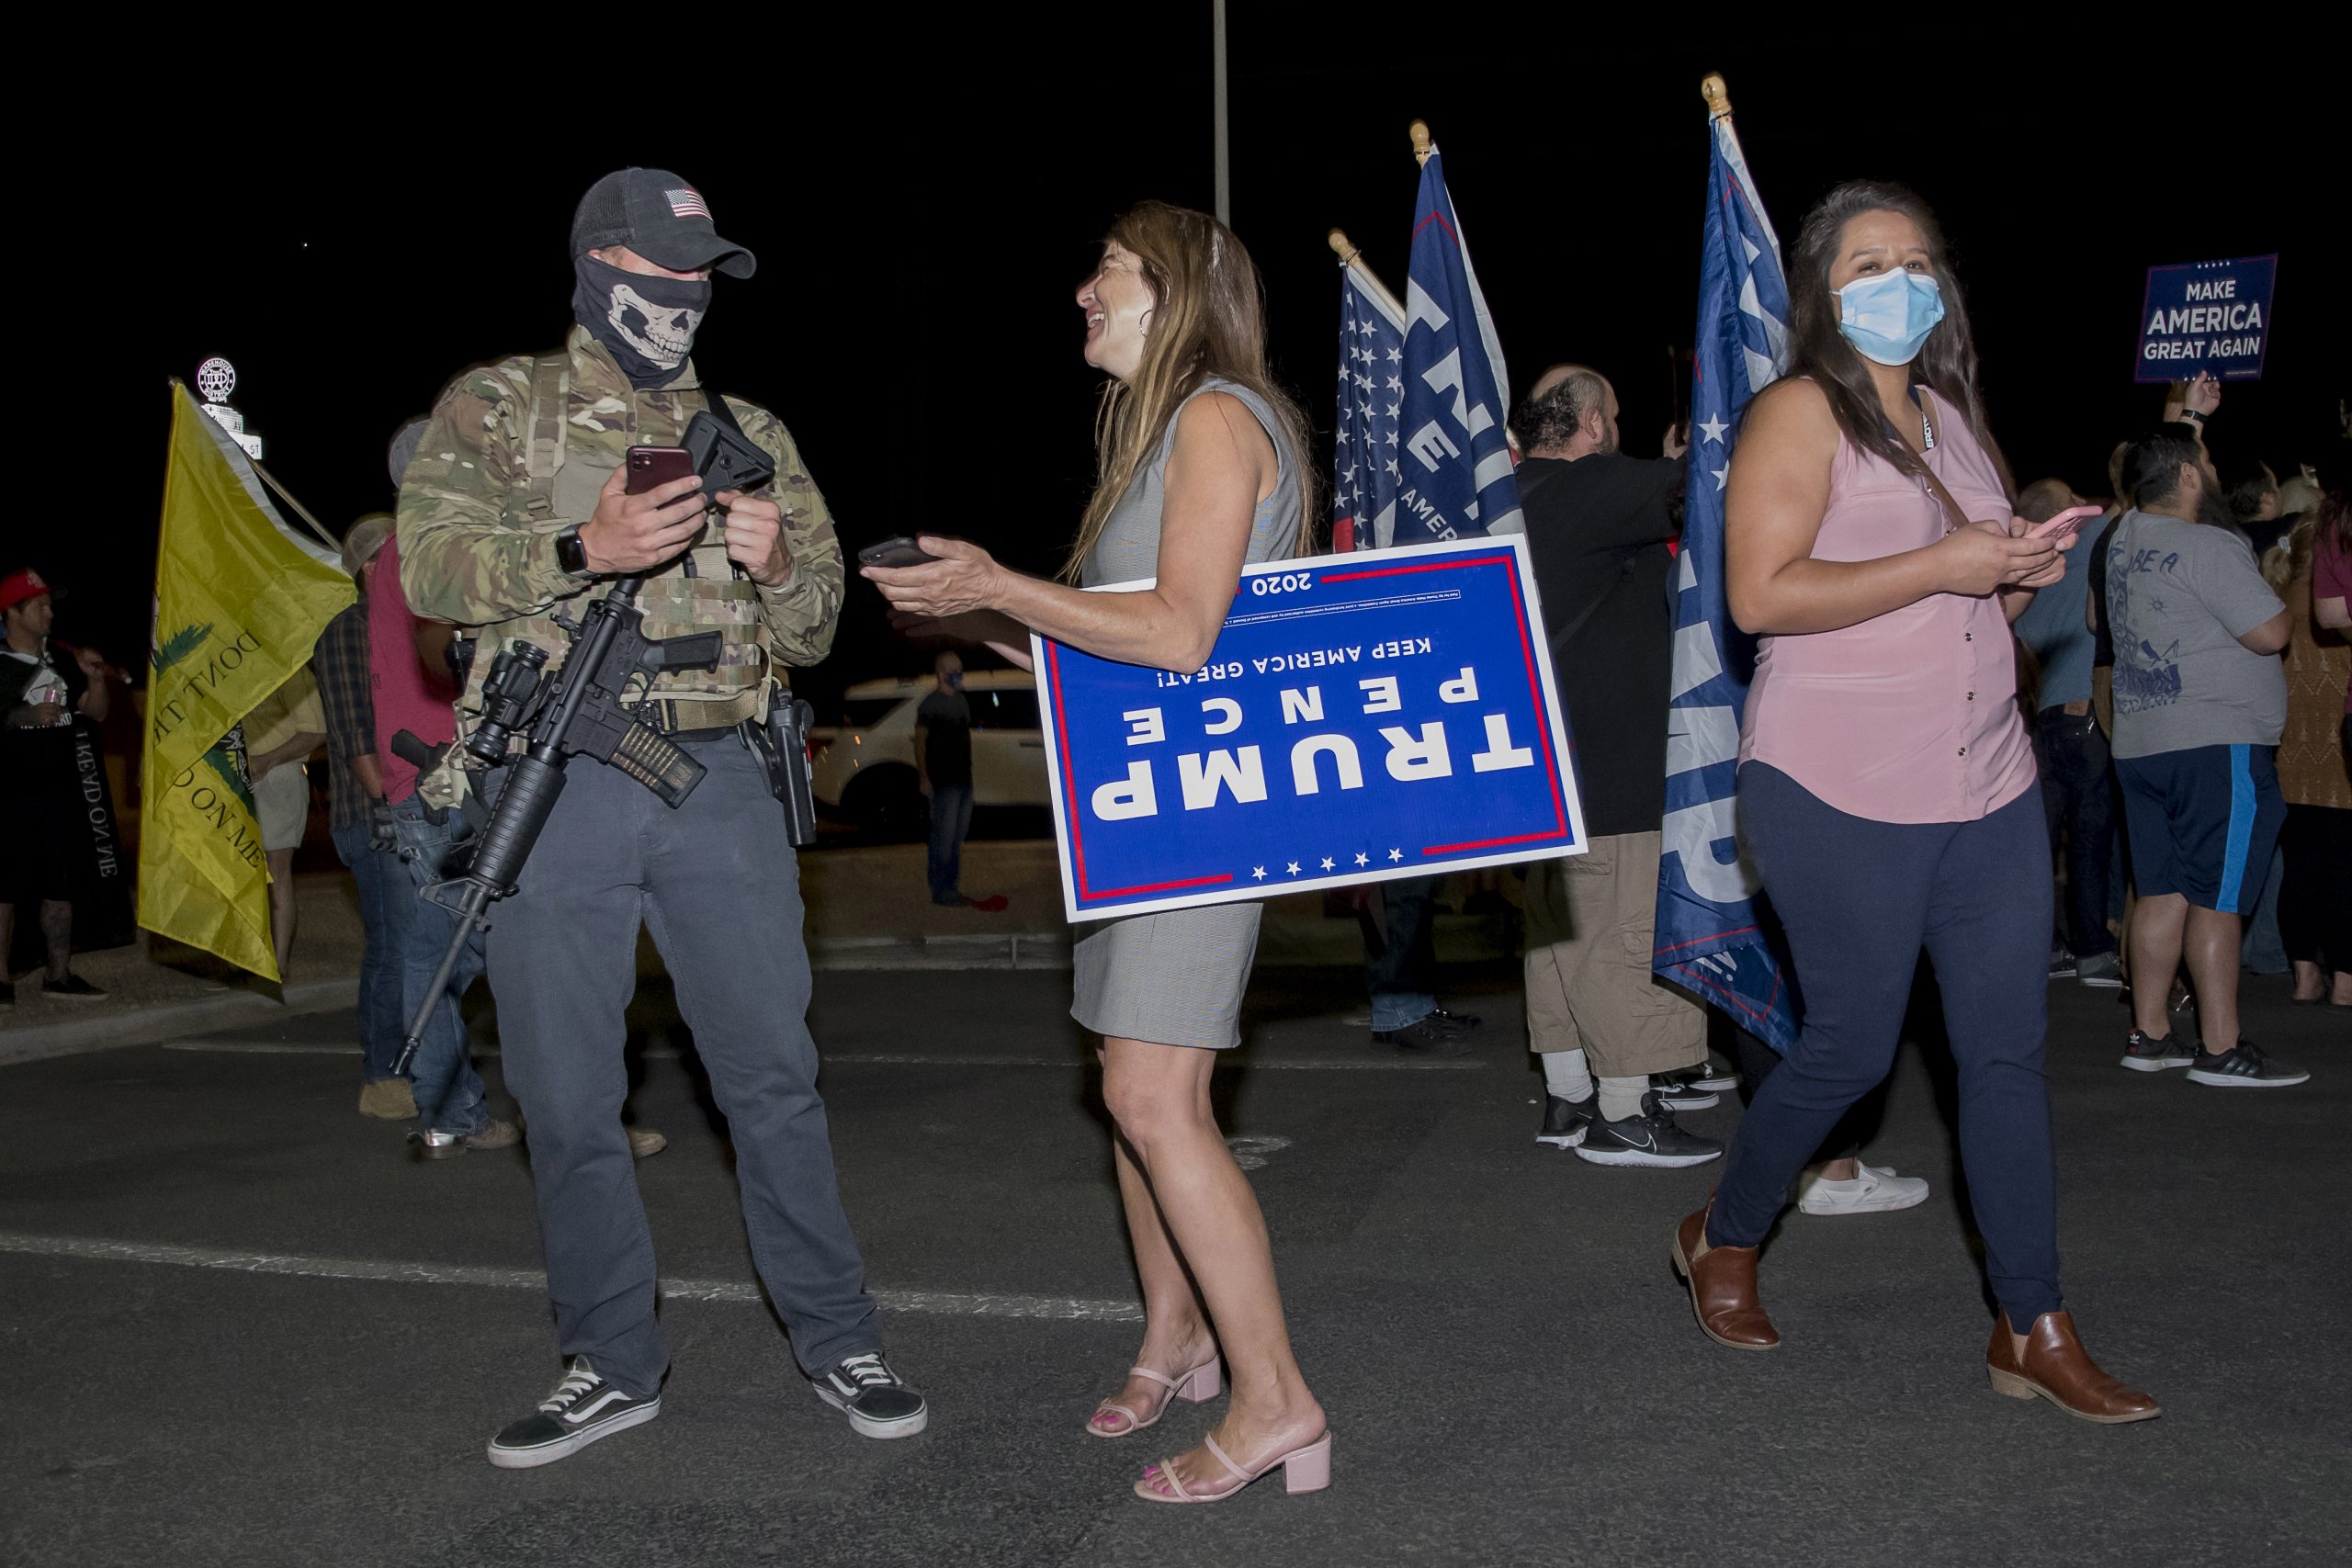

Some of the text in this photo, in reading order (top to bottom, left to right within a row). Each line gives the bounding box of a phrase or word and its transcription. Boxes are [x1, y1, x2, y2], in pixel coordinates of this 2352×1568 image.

[2187, 280, 2236, 301] MAKE
[2146, 302, 2262, 334] AMERICA
[2144, 336, 2261, 359] GREAT AGAIN
[1400, 488, 1458, 542] AMER
[1251, 572, 1312, 596] 2020
[1157, 637, 1431, 688] KEEP AMERICA GREAT!
[1123, 666, 1479, 746] PENCE
[1091, 713, 1534, 821] TRUMP
[190, 786, 266, 869] ON ME
